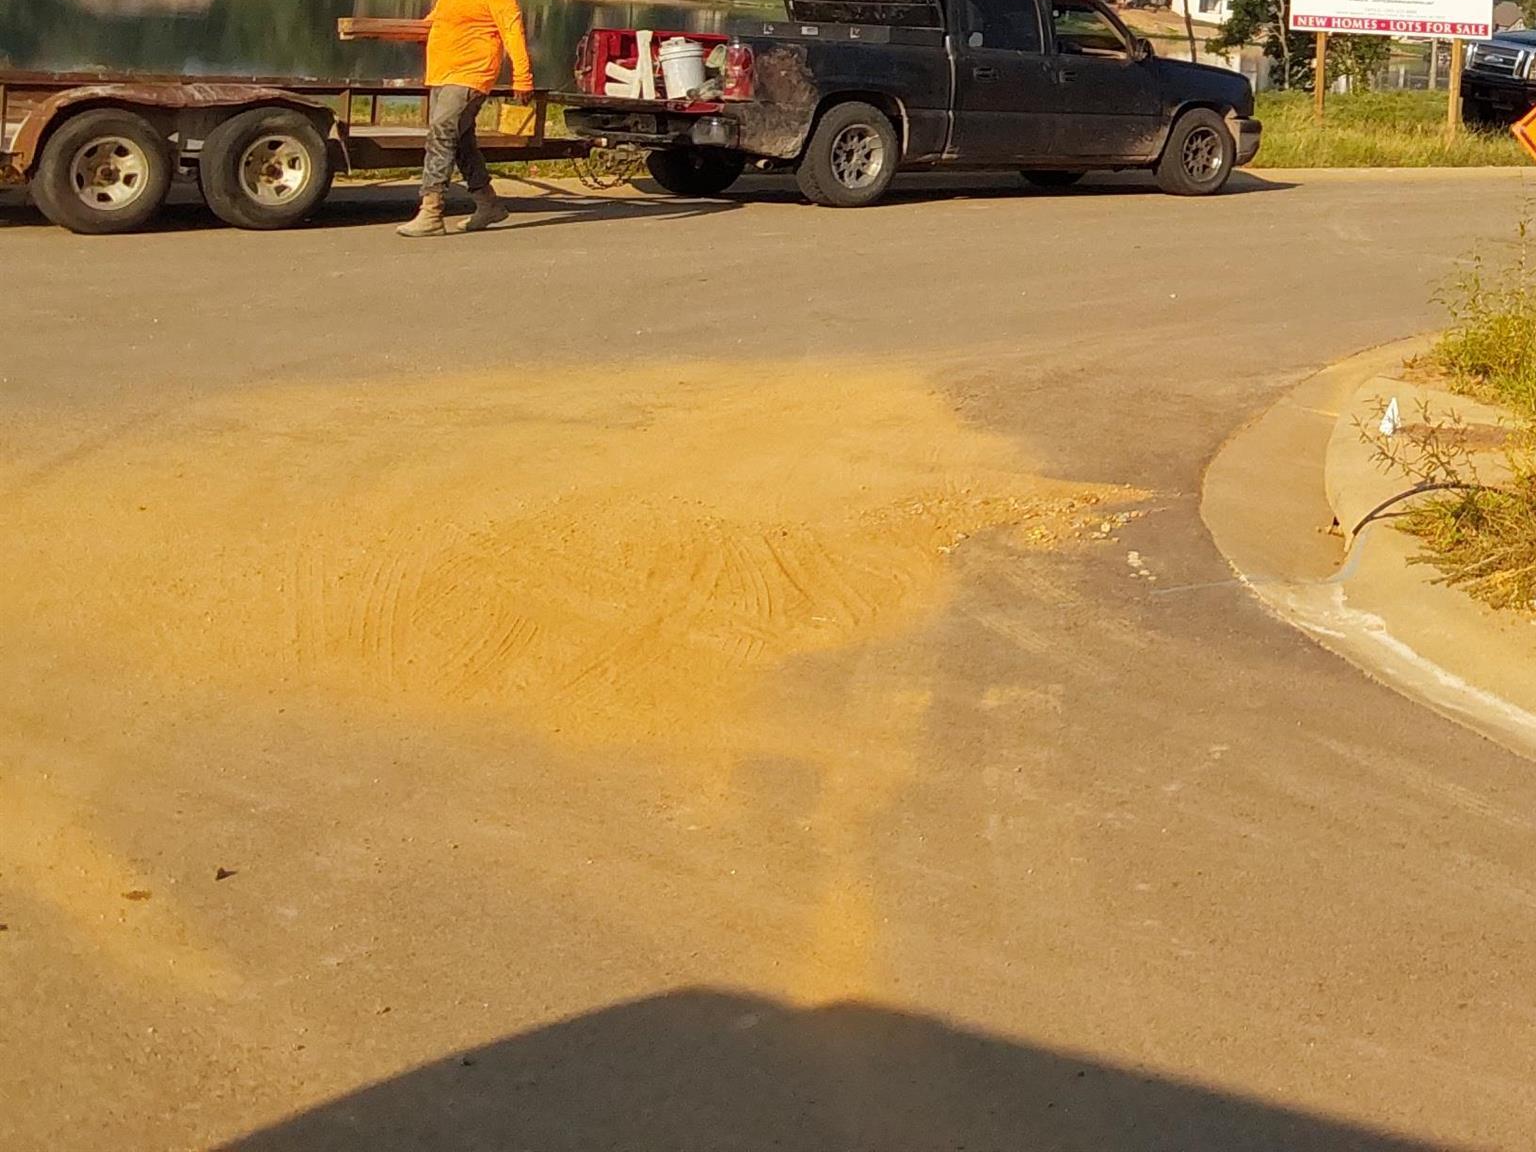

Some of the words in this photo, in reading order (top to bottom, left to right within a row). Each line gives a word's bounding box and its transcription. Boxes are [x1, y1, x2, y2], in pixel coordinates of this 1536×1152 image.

[1297, 16, 1328, 27] NEW
[1331, 17, 1378, 30] HOMES
[1390, 20, 1422, 32] LOTS
[1426, 22, 1456, 34] FOR
[1456, 24, 1487, 36] SALE
